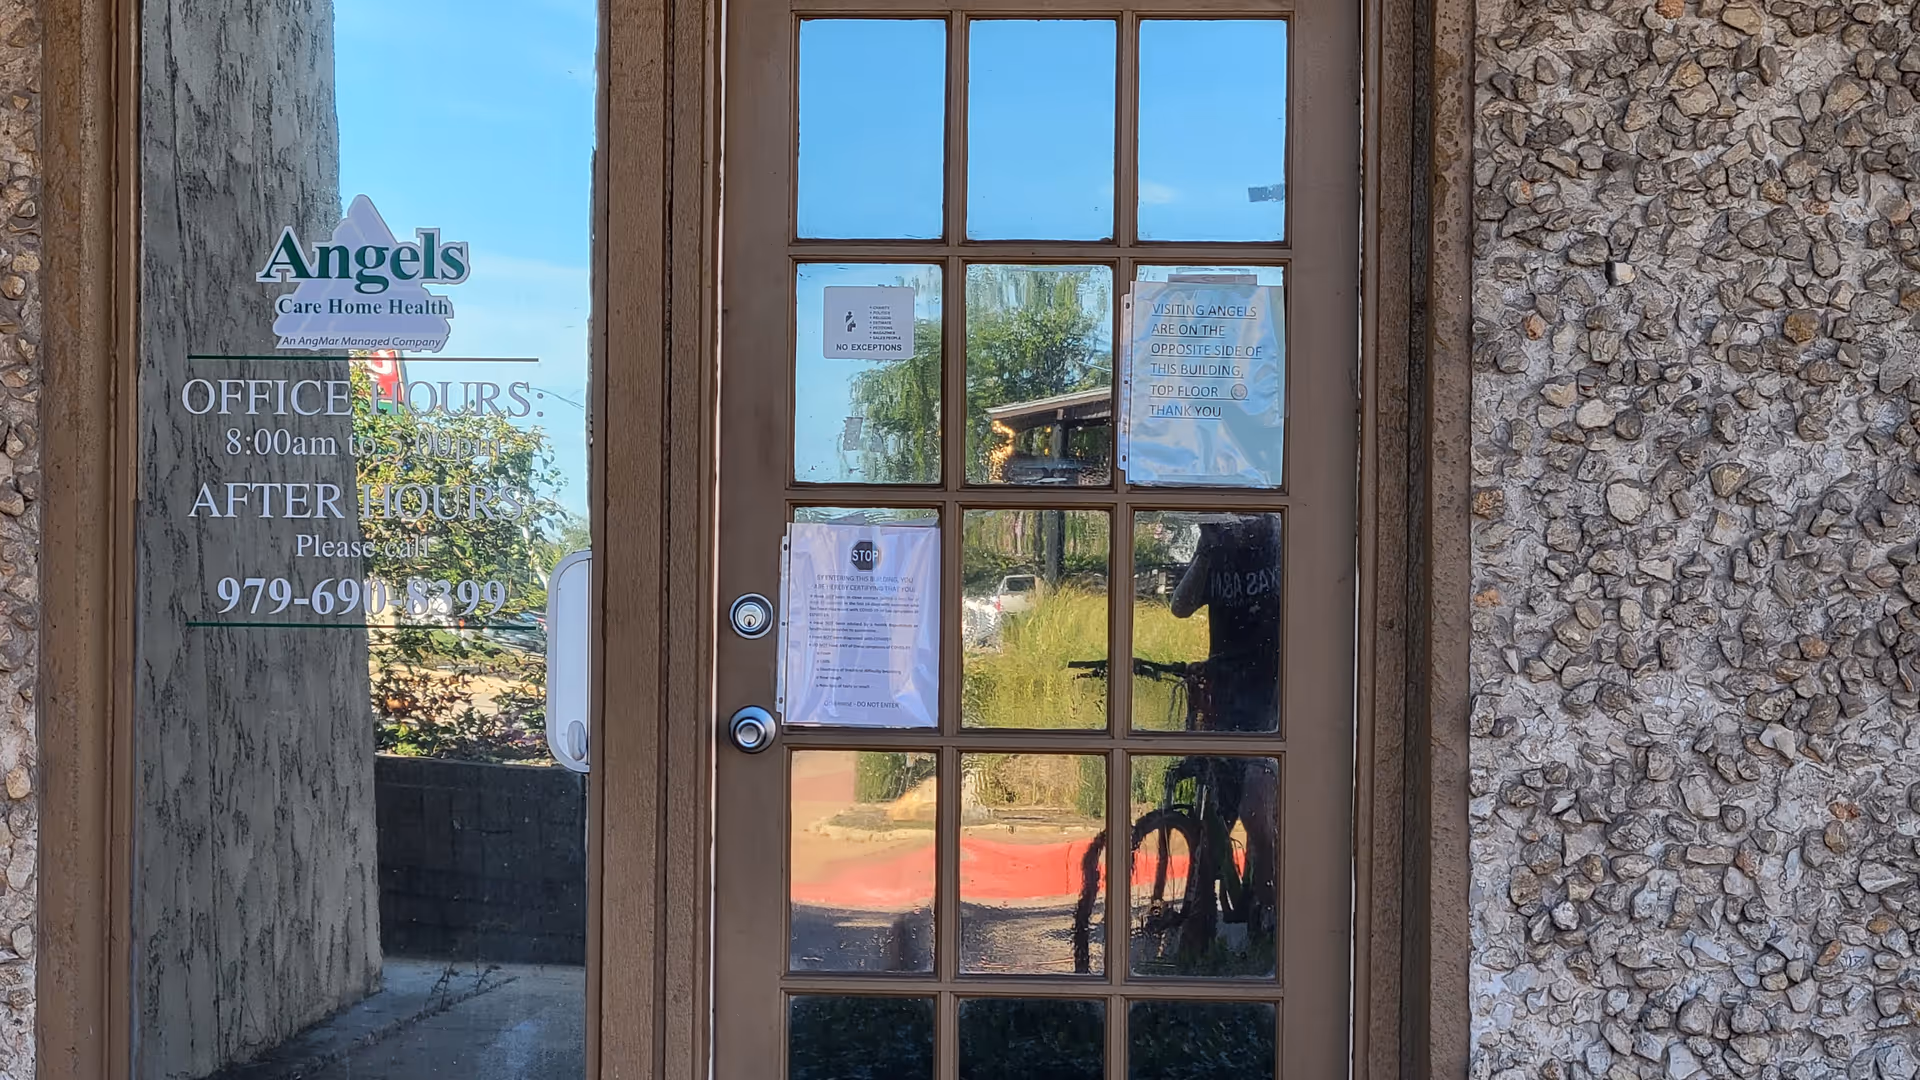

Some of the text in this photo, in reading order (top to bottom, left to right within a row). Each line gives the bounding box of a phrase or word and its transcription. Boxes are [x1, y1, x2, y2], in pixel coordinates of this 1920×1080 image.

[259, 228, 467, 295] Angels
[278, 298, 449, 316] Care Home Health
[1152, 303, 1257, 318] VISITING ANGELS
[1151, 323, 1226, 336] ARE ON THE
[281, 336, 441, 349] An AngMar Managed Company
[836, 343, 902, 352] NO EXCEPTIONS
[1151, 343, 1262, 357] OPPOSITE SIDE OF
[1150, 362, 1177, 375] THIS
[181, 378, 544, 417] OFFICE HOURS:
[1150, 384, 1219, 397] TOP FLOOR
[1149, 404, 1222, 417] THANK YOU
[225, 428, 501, 465] 8:00am to 5:00pm
[187, 482, 345, 519] AFTER
[294, 534, 429, 558] Please call
[851, 549, 879, 562] STOP
[216, 577, 506, 617] 979-690-8399
[880, 701, 900, 709] ENTER
